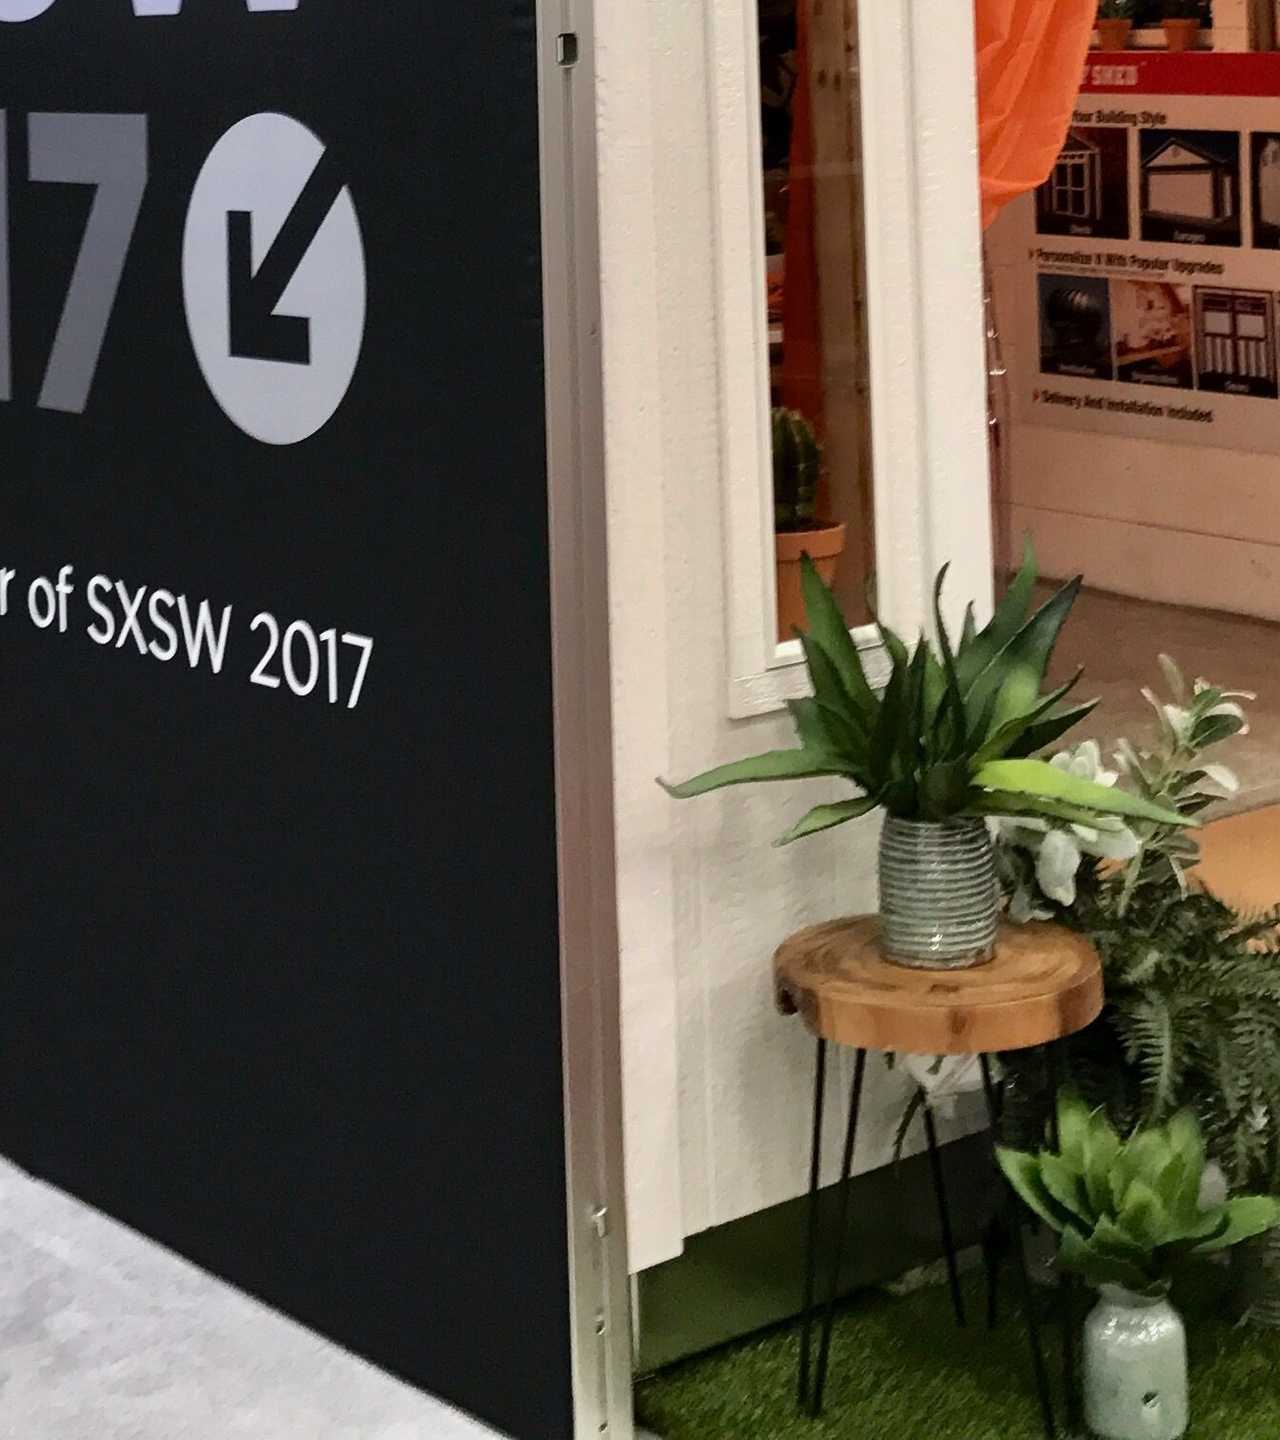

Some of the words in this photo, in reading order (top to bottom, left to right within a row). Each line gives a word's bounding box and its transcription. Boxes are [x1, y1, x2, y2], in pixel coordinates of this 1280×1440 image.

[1138, 112, 1167, 127] Style
[28, 565, 73, 633] of
[86, 574, 232, 674] SXSW
[249, 612, 374, 709] 2017
